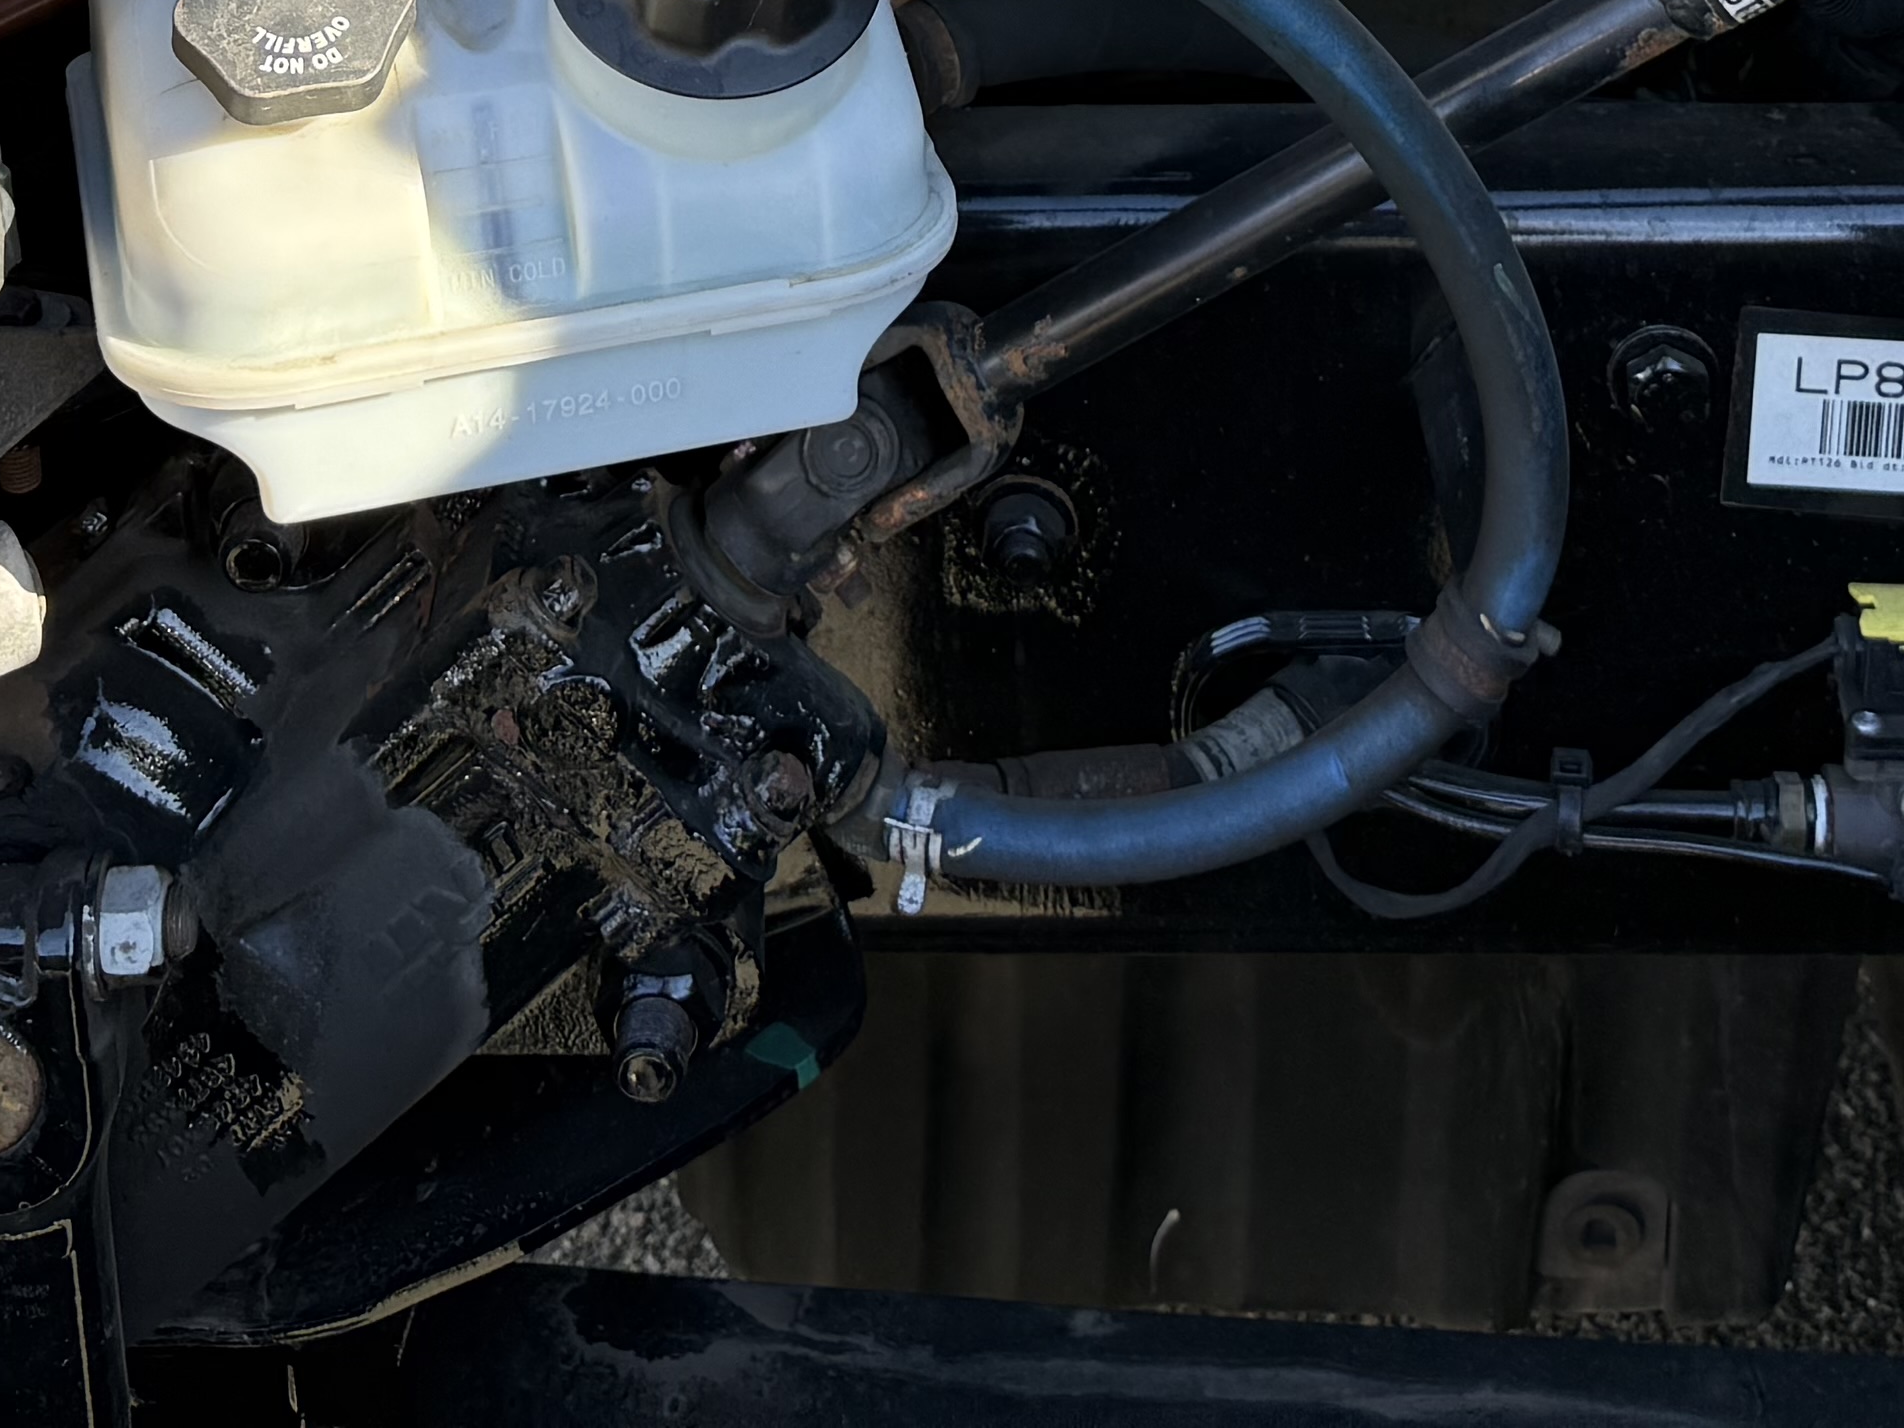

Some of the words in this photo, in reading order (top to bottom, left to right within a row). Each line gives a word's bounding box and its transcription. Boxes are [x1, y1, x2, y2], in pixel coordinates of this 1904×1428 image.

[252, 16, 350, 54] OVERFILL
[259, 54, 304, 74] NOT
[312, 47, 344, 70] DO
[509, 257, 566, 283] COLD
[450, 377, 681, 442] A14-17924-000
